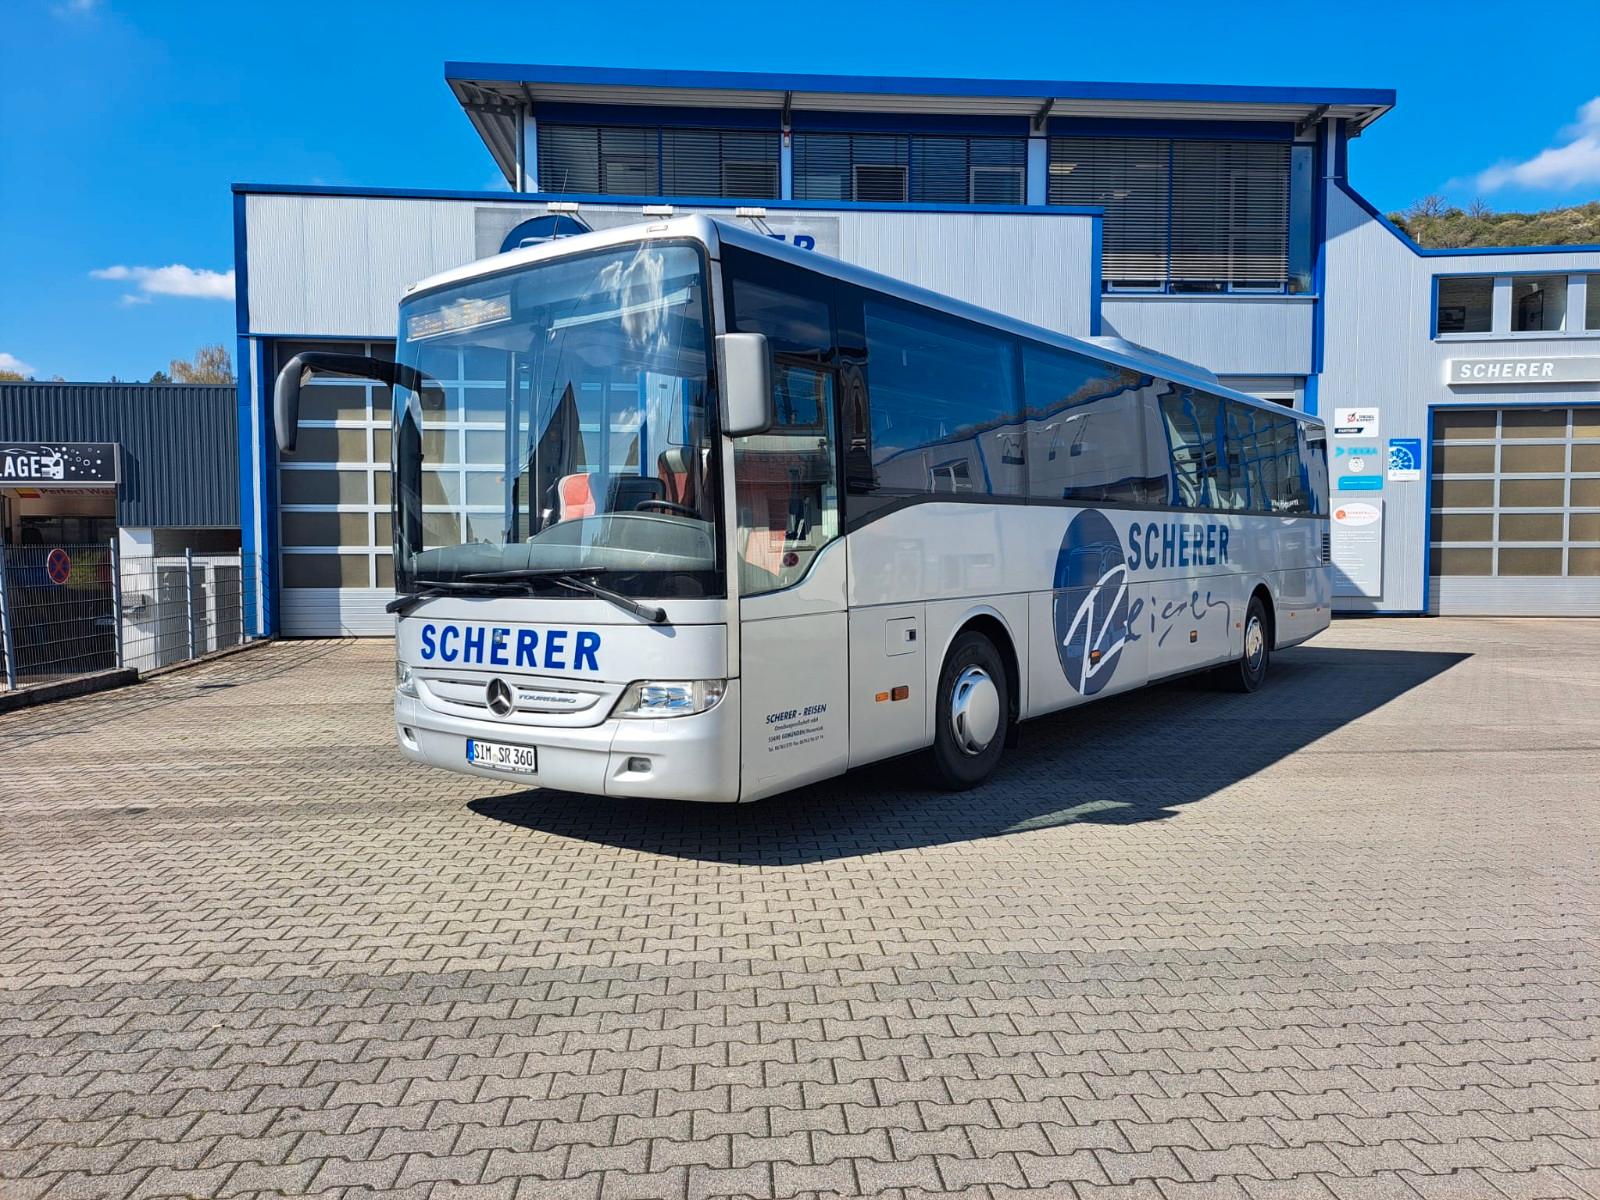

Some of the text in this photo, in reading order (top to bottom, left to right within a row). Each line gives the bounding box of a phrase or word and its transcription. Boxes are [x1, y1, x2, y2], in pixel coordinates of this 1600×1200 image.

[1460, 362, 1554, 378] SCHERER
[0, 456, 41, 478] AGE
[1128, 522, 1229, 571] SCHERER
[420, 624, 602, 671] SCHERER
[766, 710, 797, 724] SCHERER
[803, 703, 827, 716] REISEN
[474, 743, 492, 761] SIM
[498, 746, 511, 764] SR
[513, 748, 533, 767] 360
